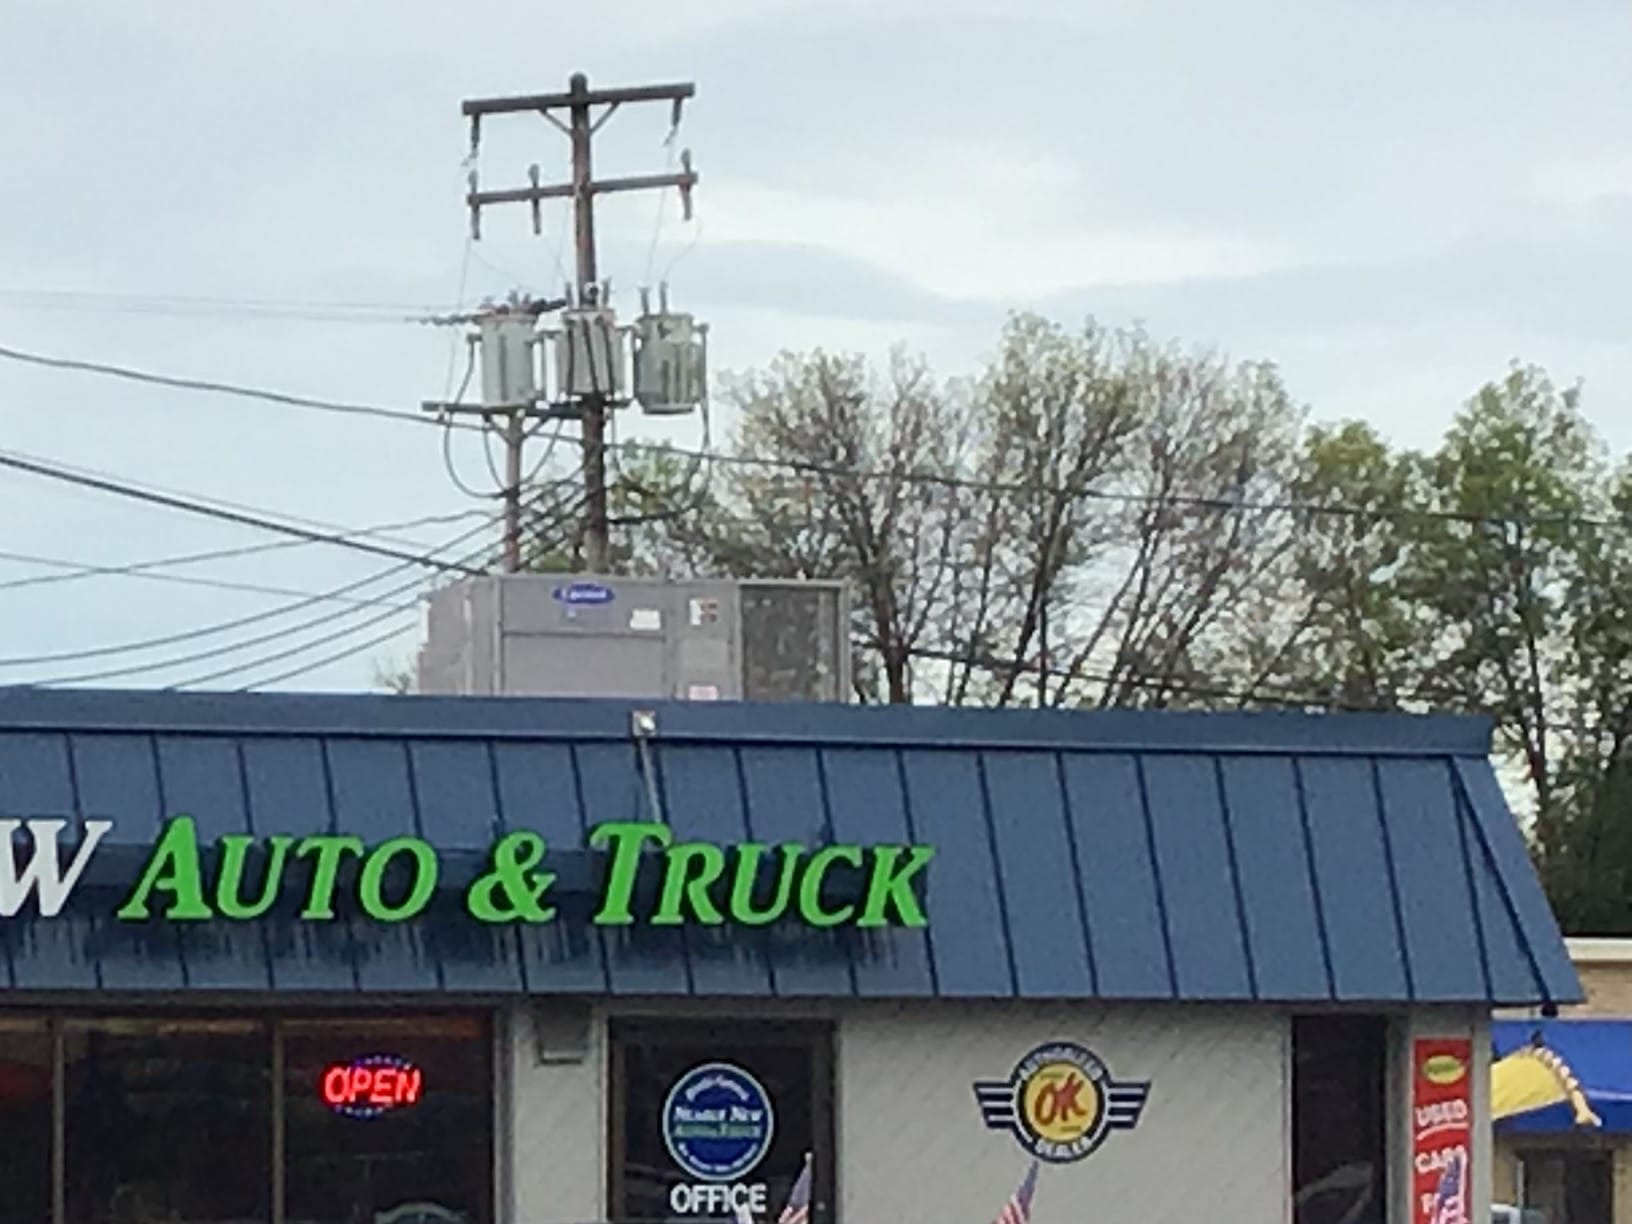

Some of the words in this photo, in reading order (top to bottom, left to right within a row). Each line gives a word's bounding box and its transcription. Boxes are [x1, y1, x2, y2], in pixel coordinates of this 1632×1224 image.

[118, 815, 438, 922] AUTO
[469, 832, 556, 923] &
[590, 822, 934, 927] TRUCK
[324, 1065, 422, 1104] OPEN
[1033, 1071, 1087, 1126] OK
[670, 1183, 767, 1214] OFFICE
